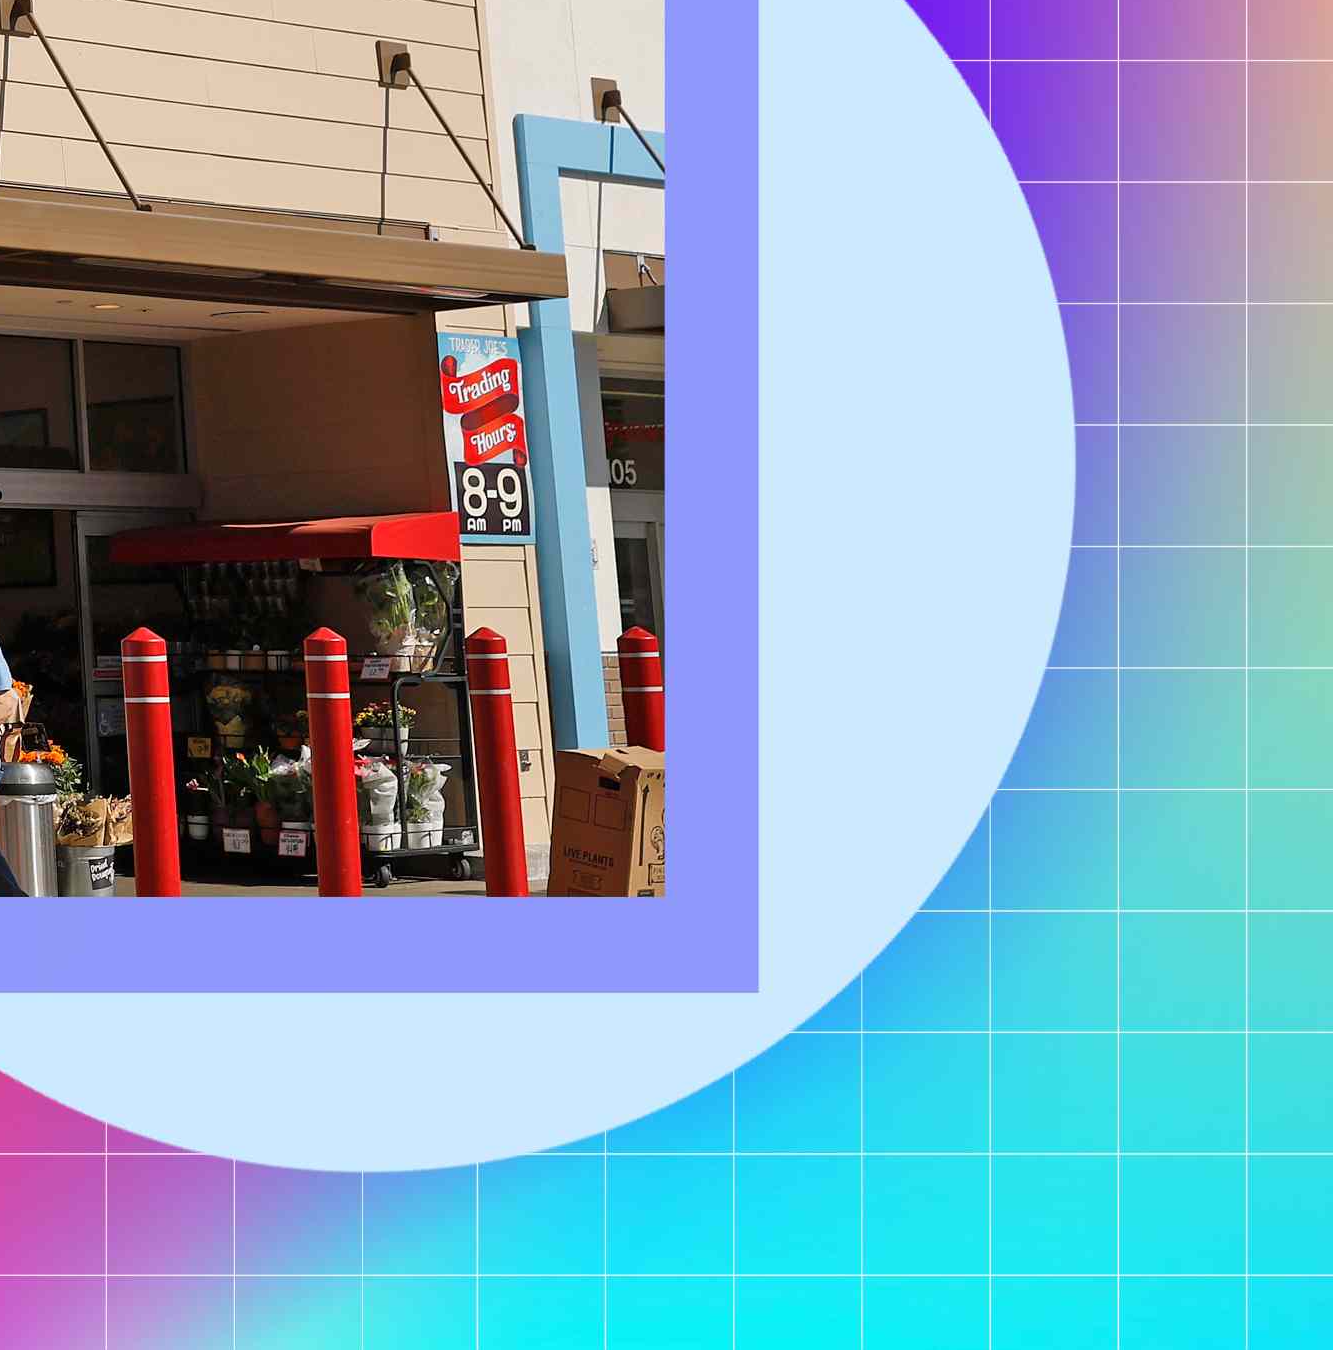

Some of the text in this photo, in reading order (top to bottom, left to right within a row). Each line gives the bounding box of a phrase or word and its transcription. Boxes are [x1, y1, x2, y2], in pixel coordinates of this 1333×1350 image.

[449, 369, 511, 404] Trading
[471, 422, 517, 456] Hours:
[612, 459, 637, 485] 05
[467, 518, 522, 532] AM PM
